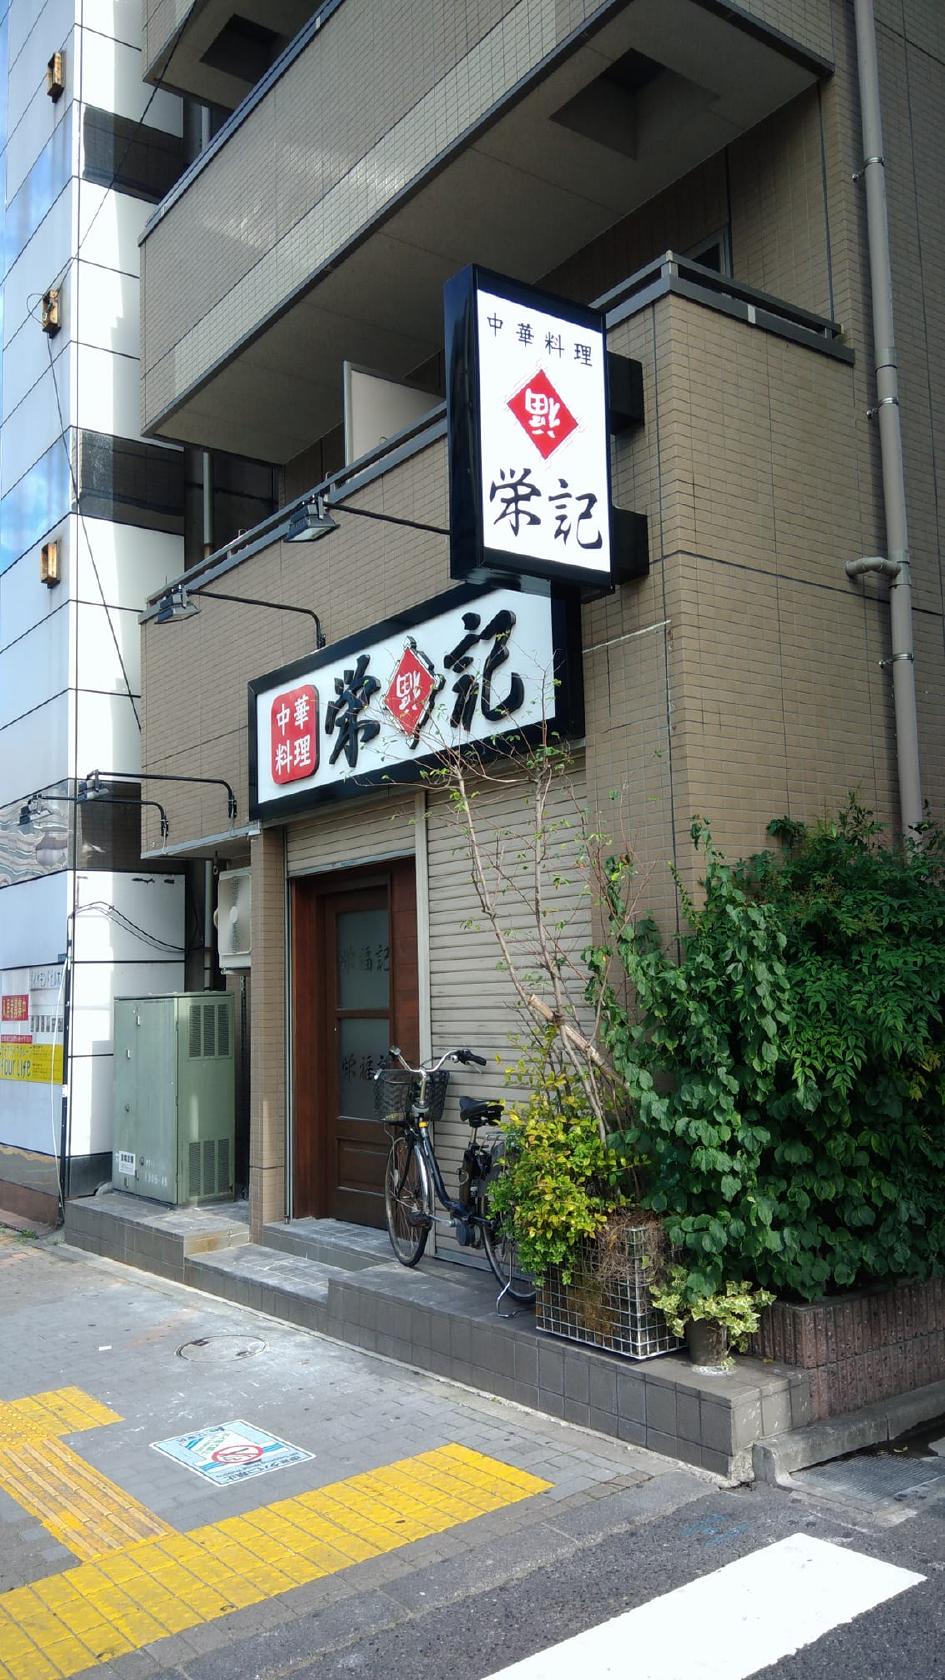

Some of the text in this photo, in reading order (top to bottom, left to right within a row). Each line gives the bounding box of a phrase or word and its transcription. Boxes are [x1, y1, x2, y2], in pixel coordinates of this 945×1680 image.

[486, 312, 594, 368] 中華料理
[489, 467, 603, 550] 栄記
[275, 693, 311, 737] 中華
[275, 737, 311, 776] 料理
